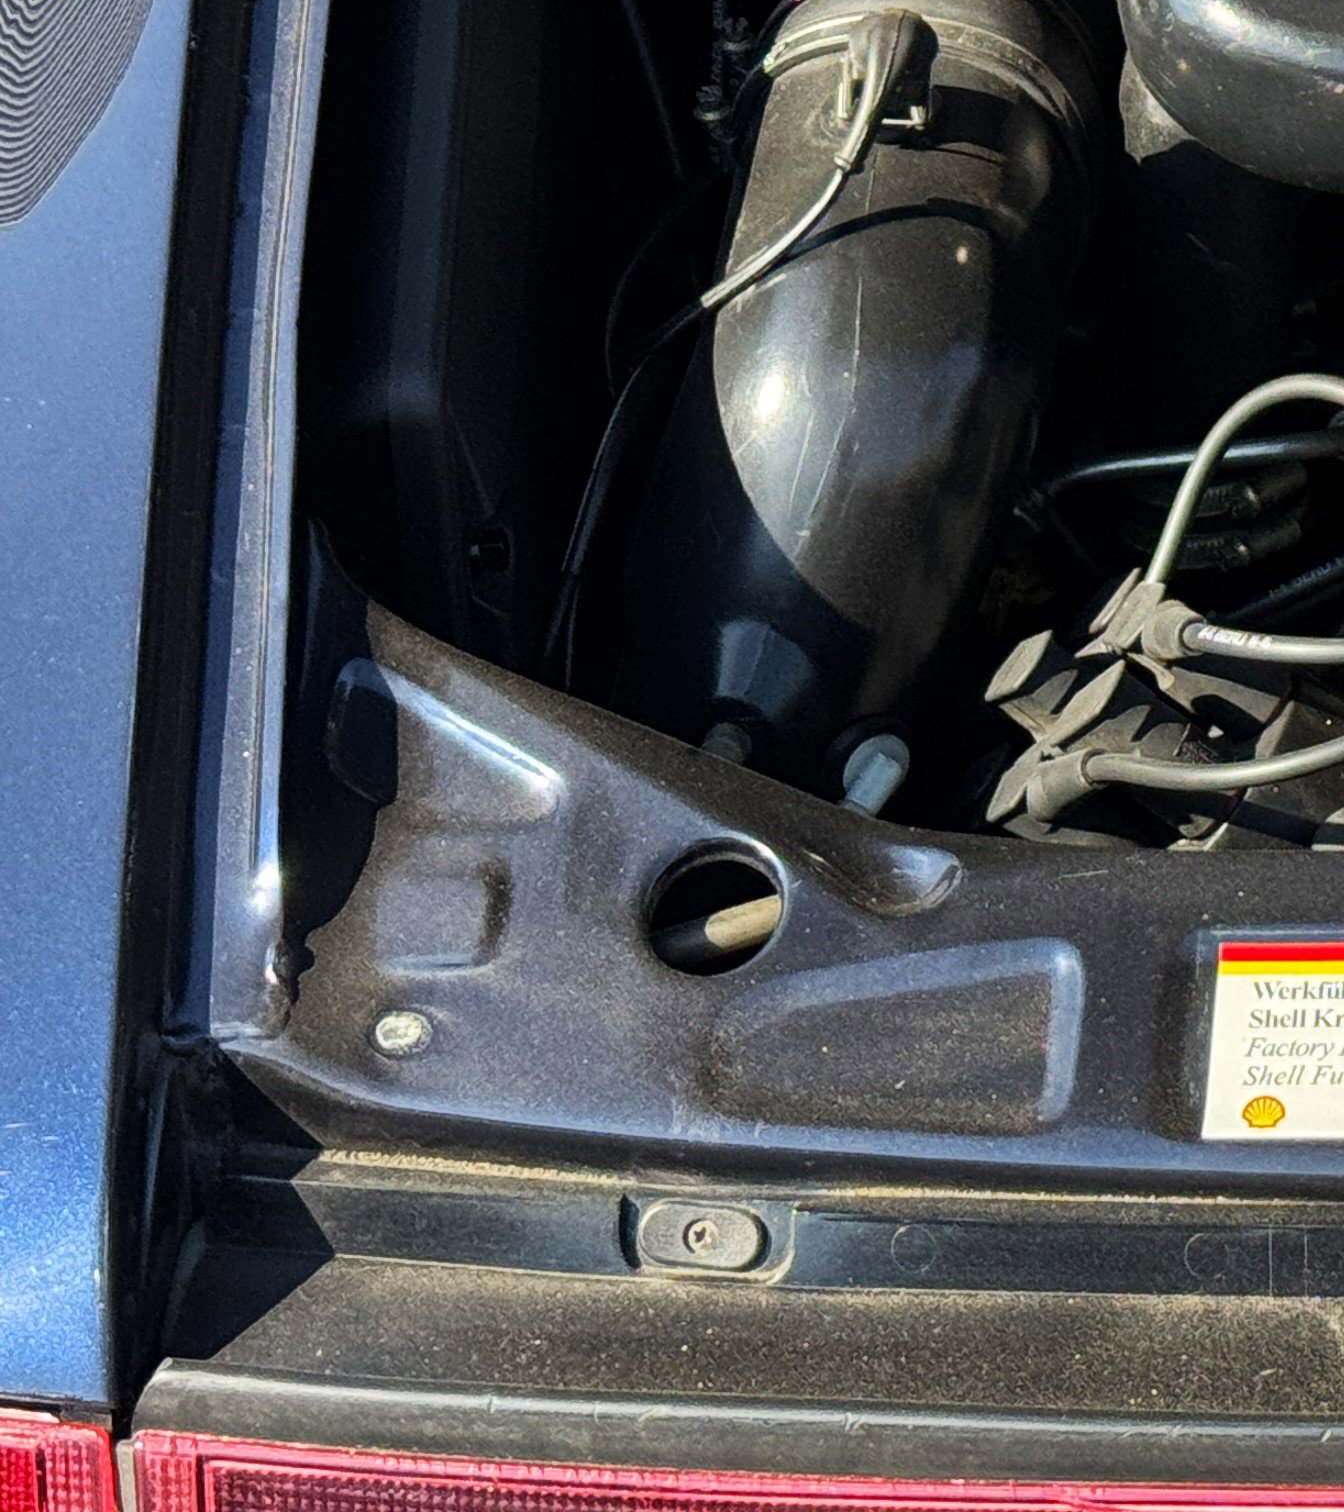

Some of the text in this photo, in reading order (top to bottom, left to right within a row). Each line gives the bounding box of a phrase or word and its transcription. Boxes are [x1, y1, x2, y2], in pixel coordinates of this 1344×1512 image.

[1248, 1008, 1307, 1029] Shell
[1244, 1036, 1336, 1062] Factory
[1242, 1065, 1306, 1086] Shell
